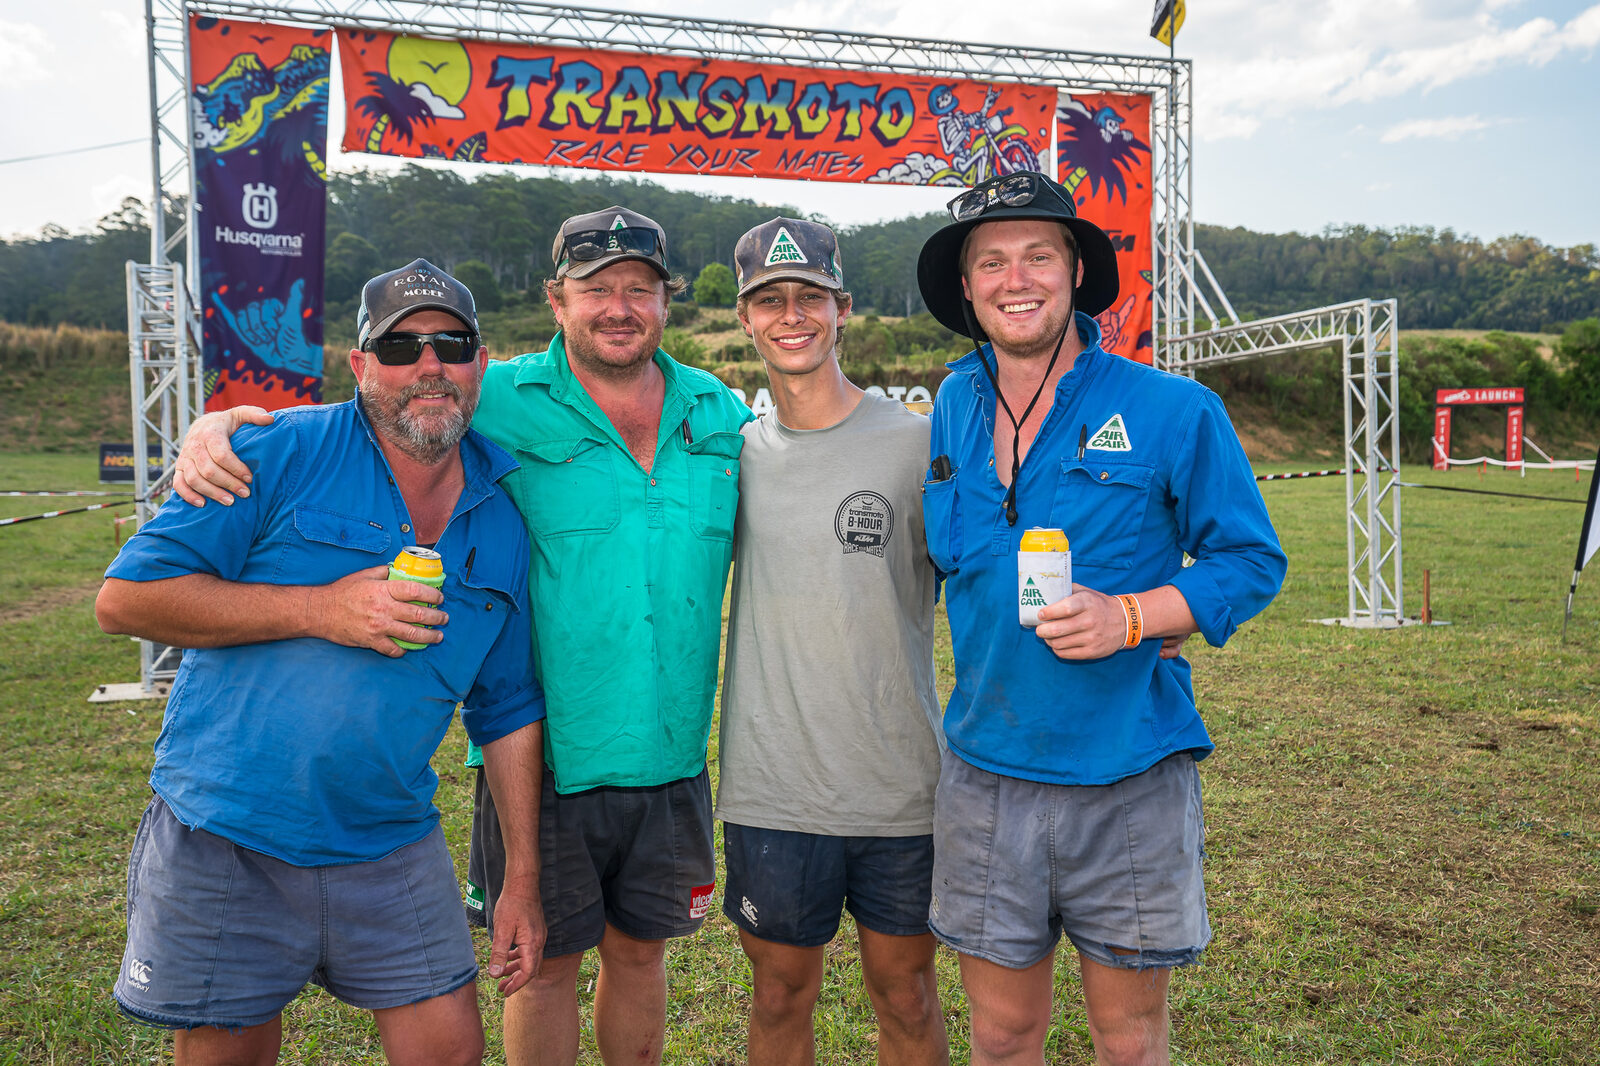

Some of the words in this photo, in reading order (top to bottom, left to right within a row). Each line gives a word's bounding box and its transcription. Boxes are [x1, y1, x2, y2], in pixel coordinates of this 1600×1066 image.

[486, 55, 915, 147] TRANSMOTO
[544, 139, 649, 166] RACE
[665, 143, 761, 171] YOUR
[775, 149, 864, 177] MATES
[215, 225, 303, 248] Husqvarna
[1102, 229, 1136, 252] TM
[771, 243, 798, 254] AIR
[769, 252, 804, 263] CAIR
[394, 273, 451, 290] ROYAL
[1475, 390, 1516, 401] LAUNCH
[1096, 430, 1124, 441] AIR
[1091, 438, 1127, 449] CAIR
[849, 508, 884, 519] transmoto
[847, 516, 883, 531] 8-HOUR
[1021, 588, 1043, 598] AIR
[1020, 597, 1048, 607] CAIR
[1128, 606, 1139, 632] RIDER
